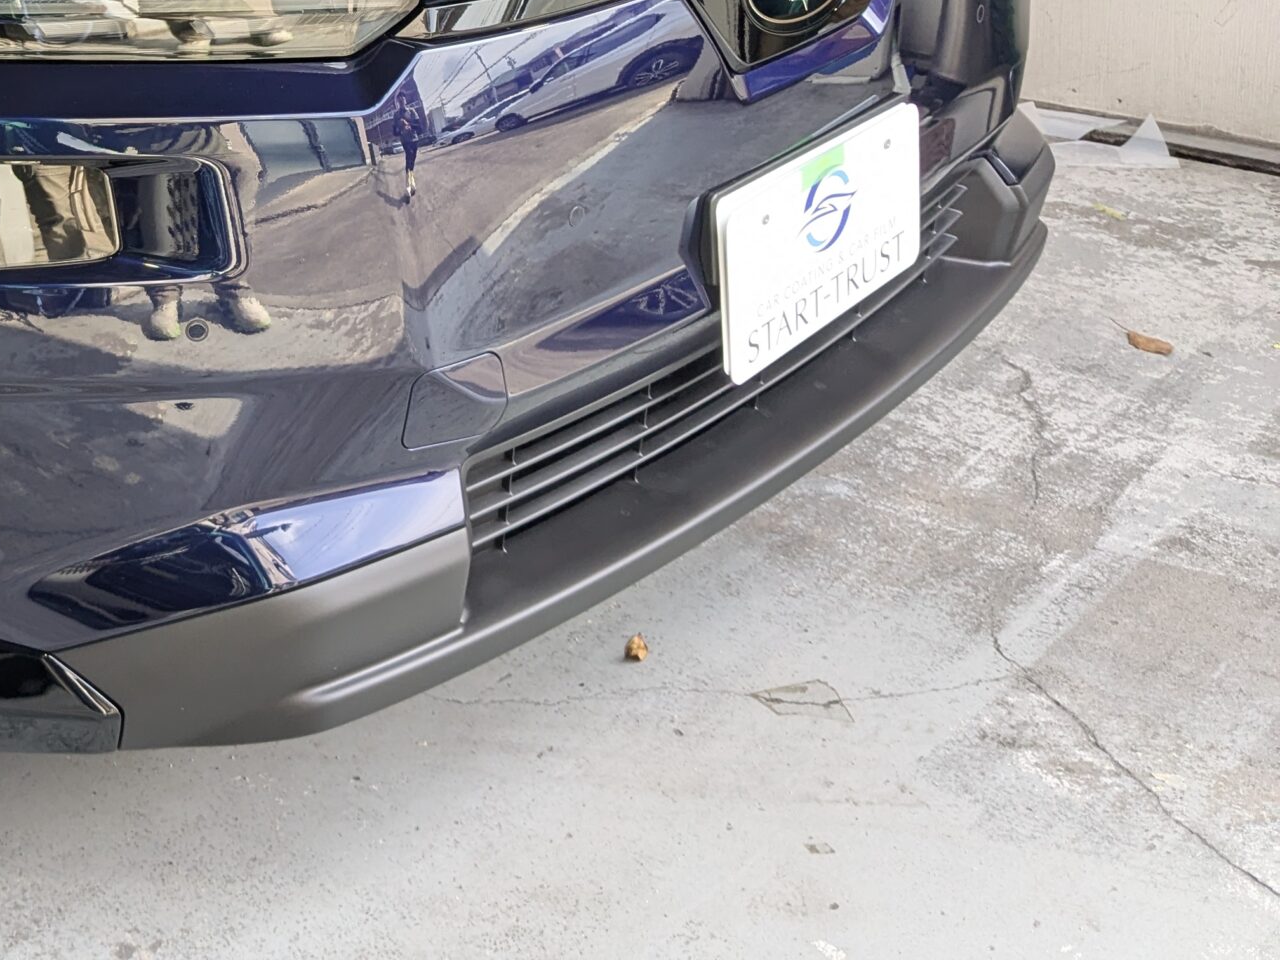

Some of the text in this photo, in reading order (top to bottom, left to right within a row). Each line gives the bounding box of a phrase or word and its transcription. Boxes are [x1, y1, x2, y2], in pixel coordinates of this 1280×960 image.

[748, 230, 905, 364] START-TRUST
[757, 294, 780, 318] CAR
[784, 255, 833, 301] COATING
